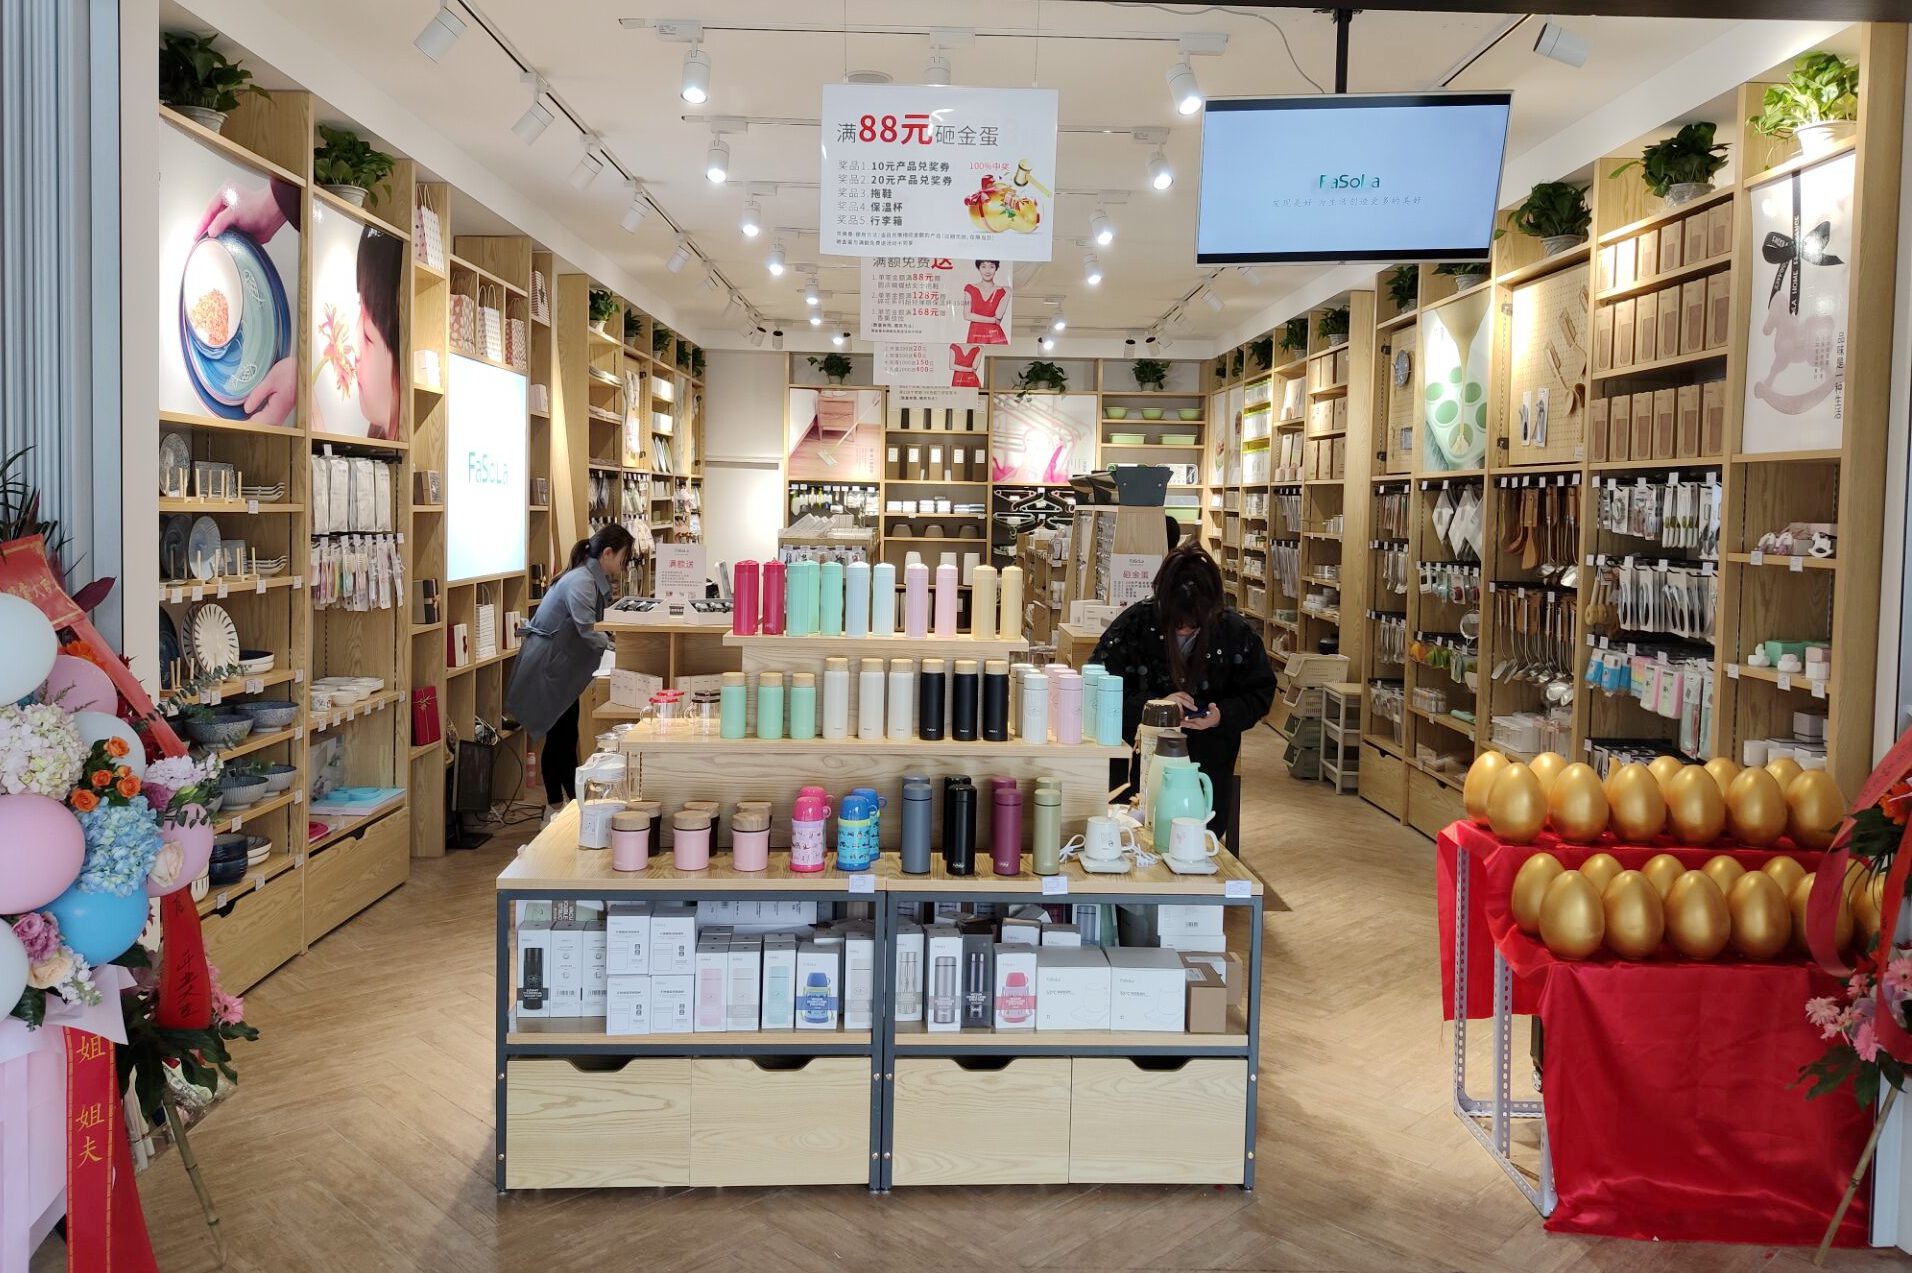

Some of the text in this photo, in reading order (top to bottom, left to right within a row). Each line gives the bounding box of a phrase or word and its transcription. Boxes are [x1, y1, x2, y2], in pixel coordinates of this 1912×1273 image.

[837, 114, 999, 146] 满88元砸金蛋
[75, 1034, 106, 1168] 姐 姐夫
